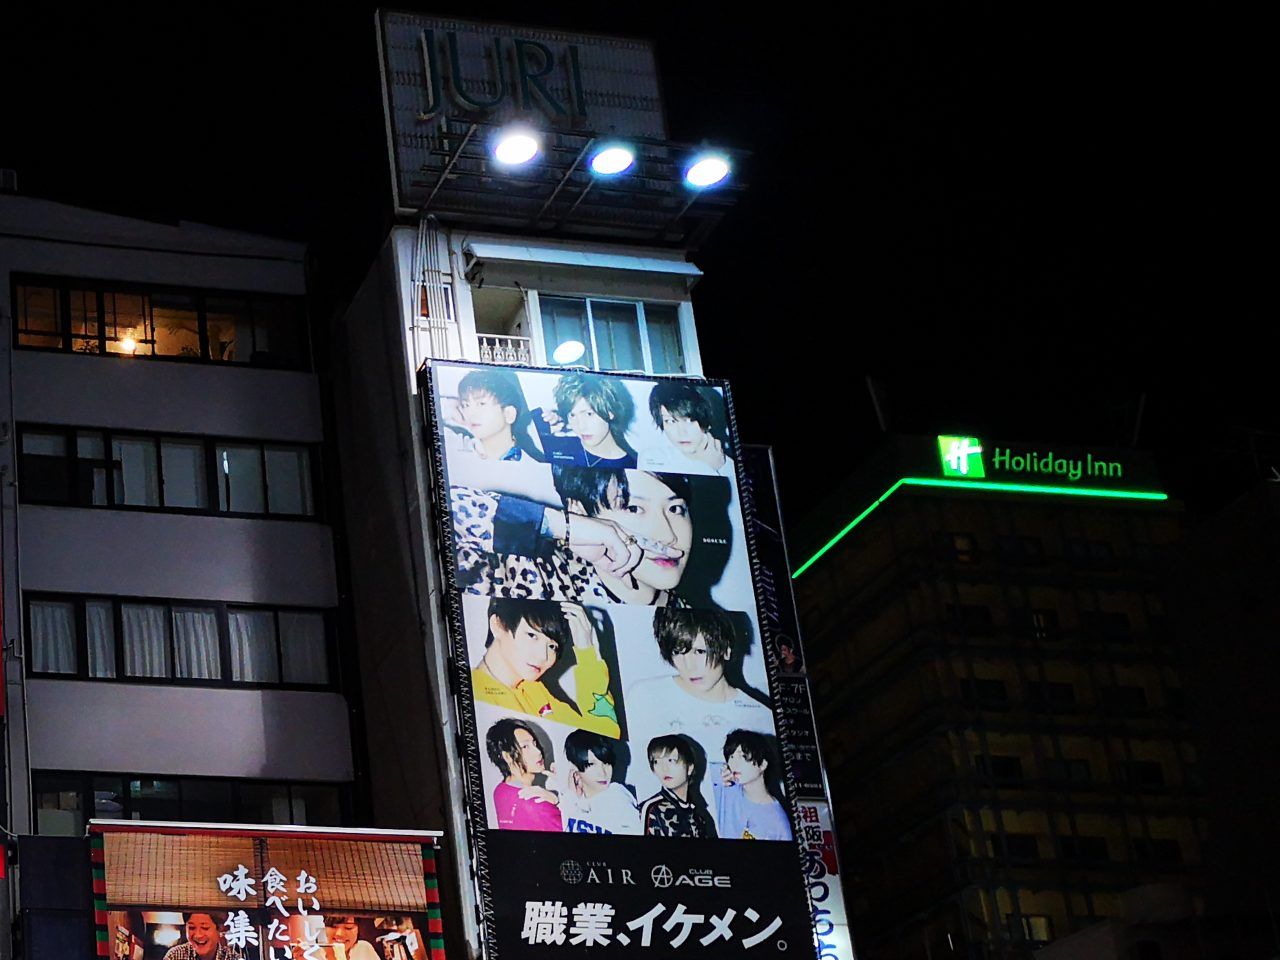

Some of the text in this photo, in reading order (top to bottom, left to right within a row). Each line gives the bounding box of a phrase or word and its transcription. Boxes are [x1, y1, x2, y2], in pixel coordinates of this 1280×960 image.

[419, 29, 587, 120] JURI
[993, 448, 1122, 480] Holiday Inn
[587, 869, 636, 885] AIR
[675, 875, 732, 888] AGE
[521, 901, 787, 950] 職業、イケメン。
